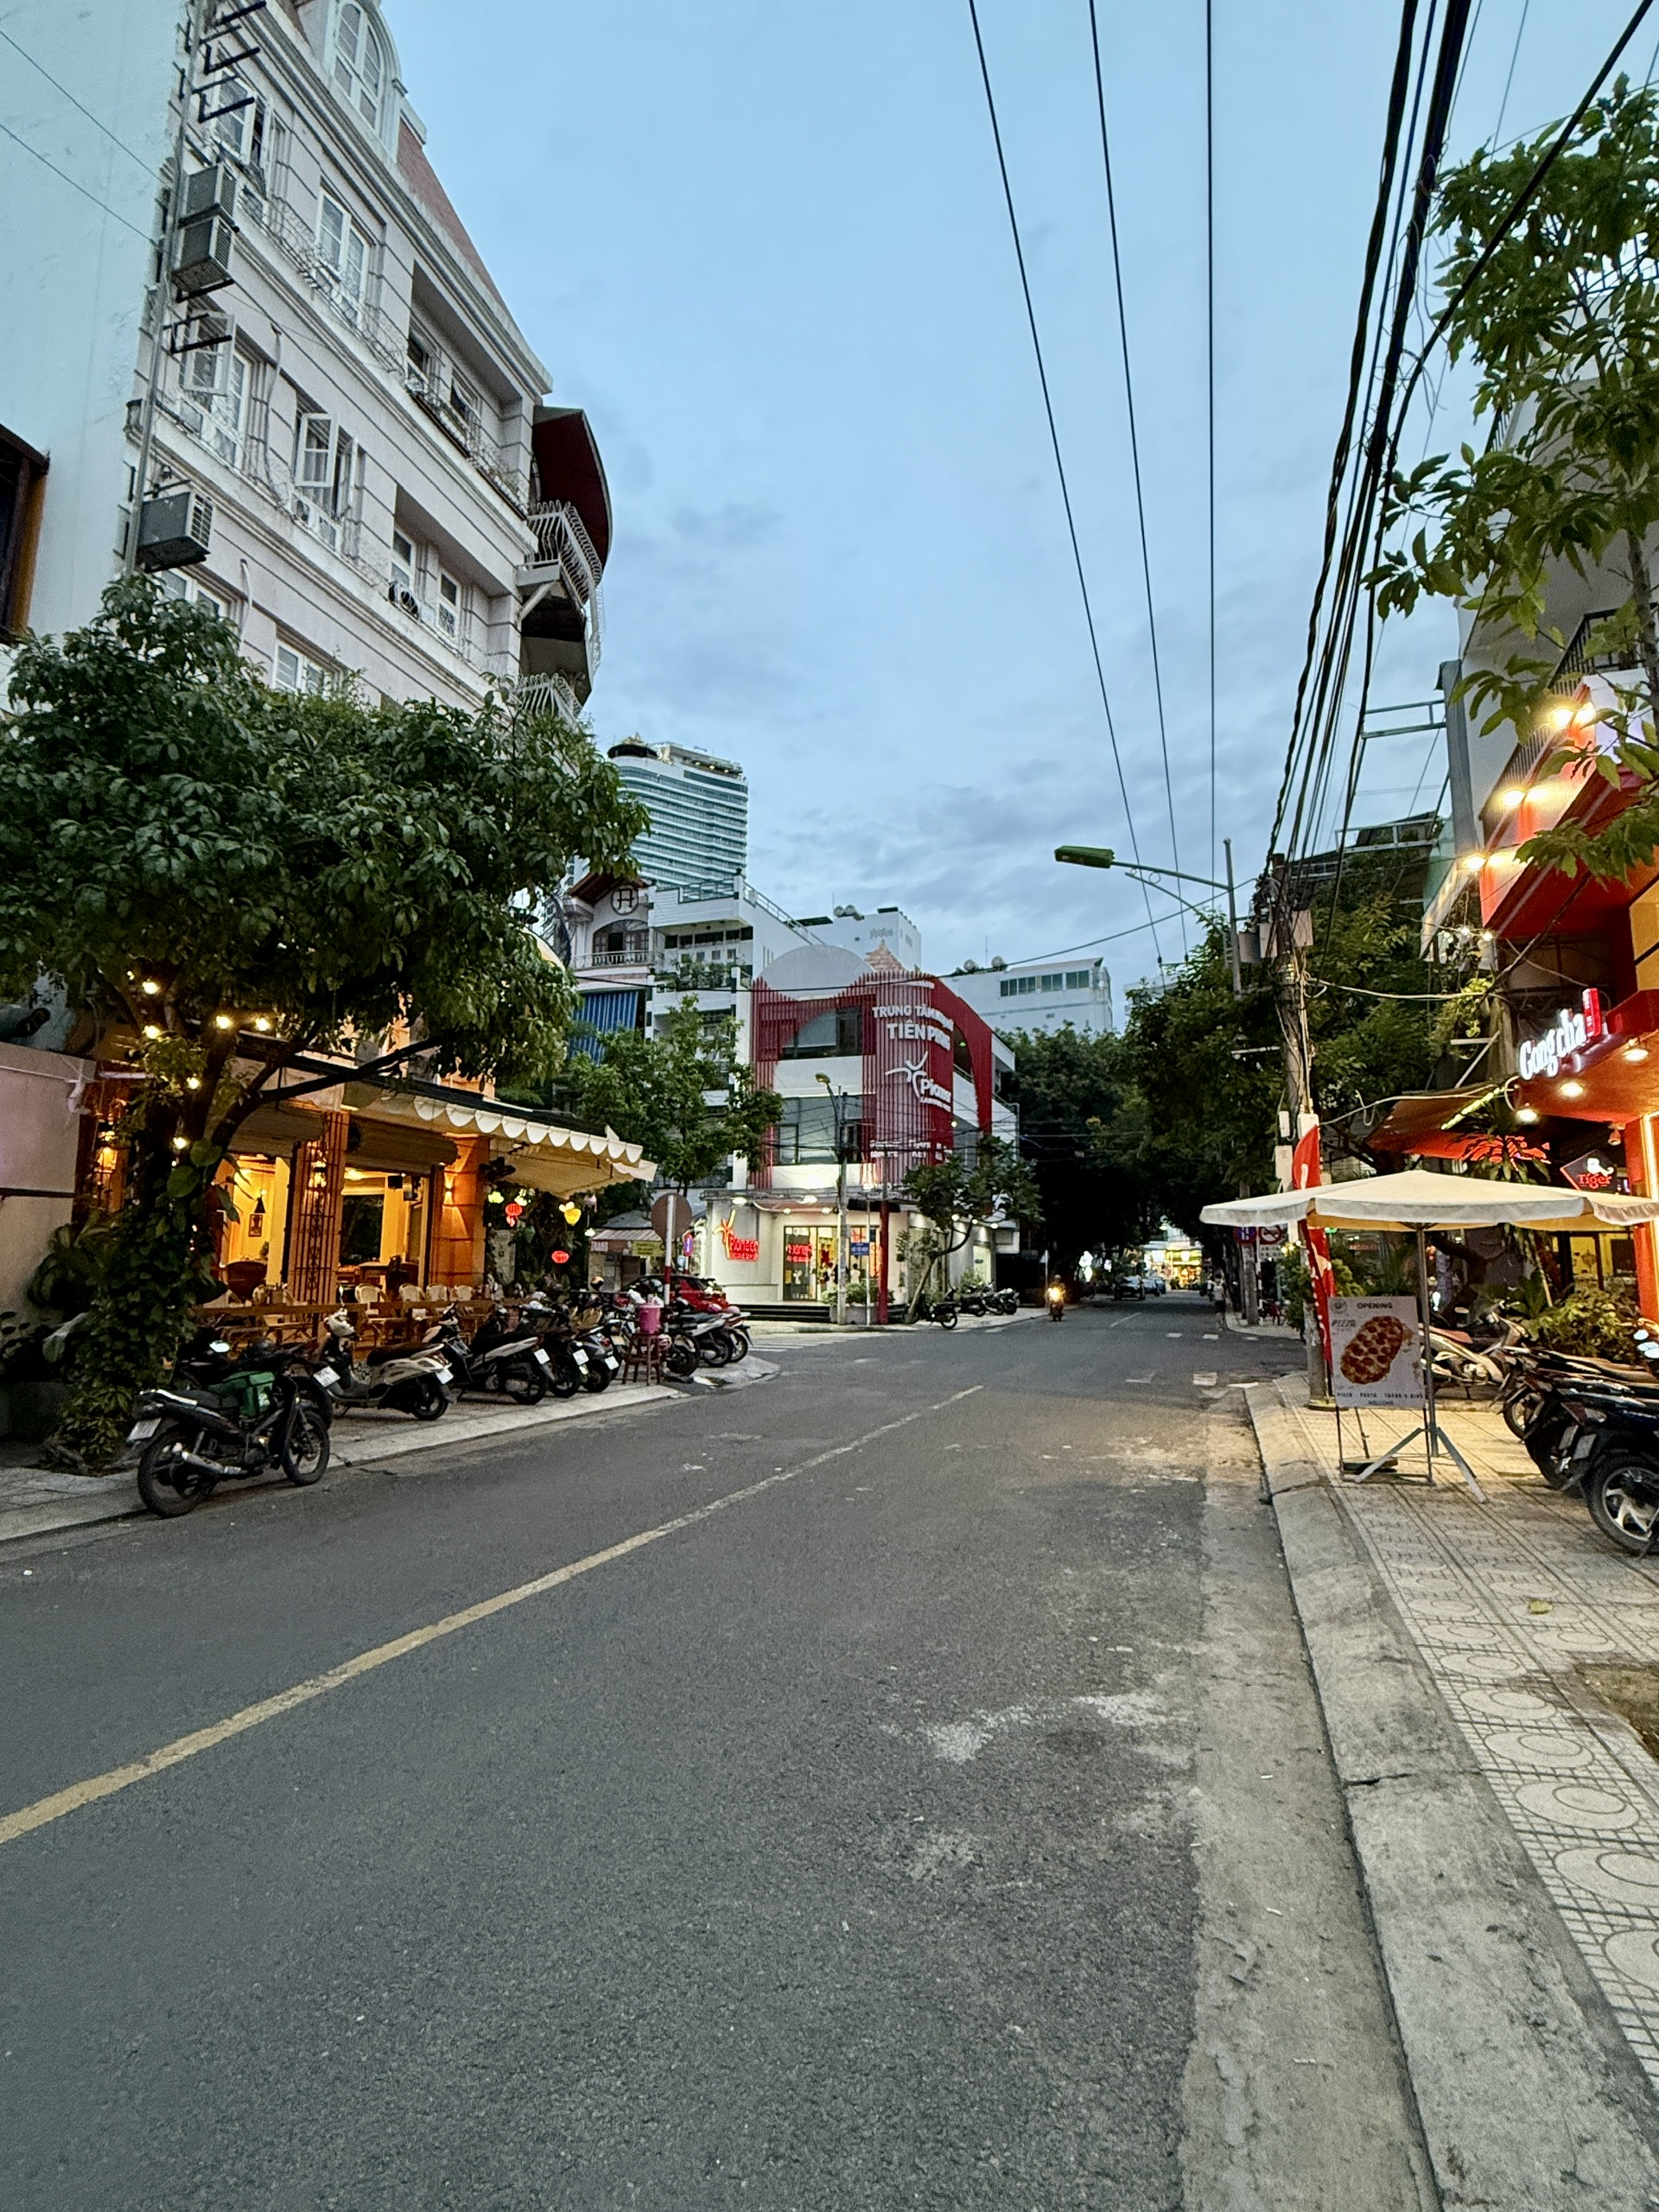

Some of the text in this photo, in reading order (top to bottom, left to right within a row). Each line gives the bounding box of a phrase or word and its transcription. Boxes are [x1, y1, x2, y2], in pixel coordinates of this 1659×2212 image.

[872, 1004, 934, 1019] TRUNG TÂM
[887, 1020, 925, 1040] TIÊN
[1578, 1173, 1612, 1189] Tiger
